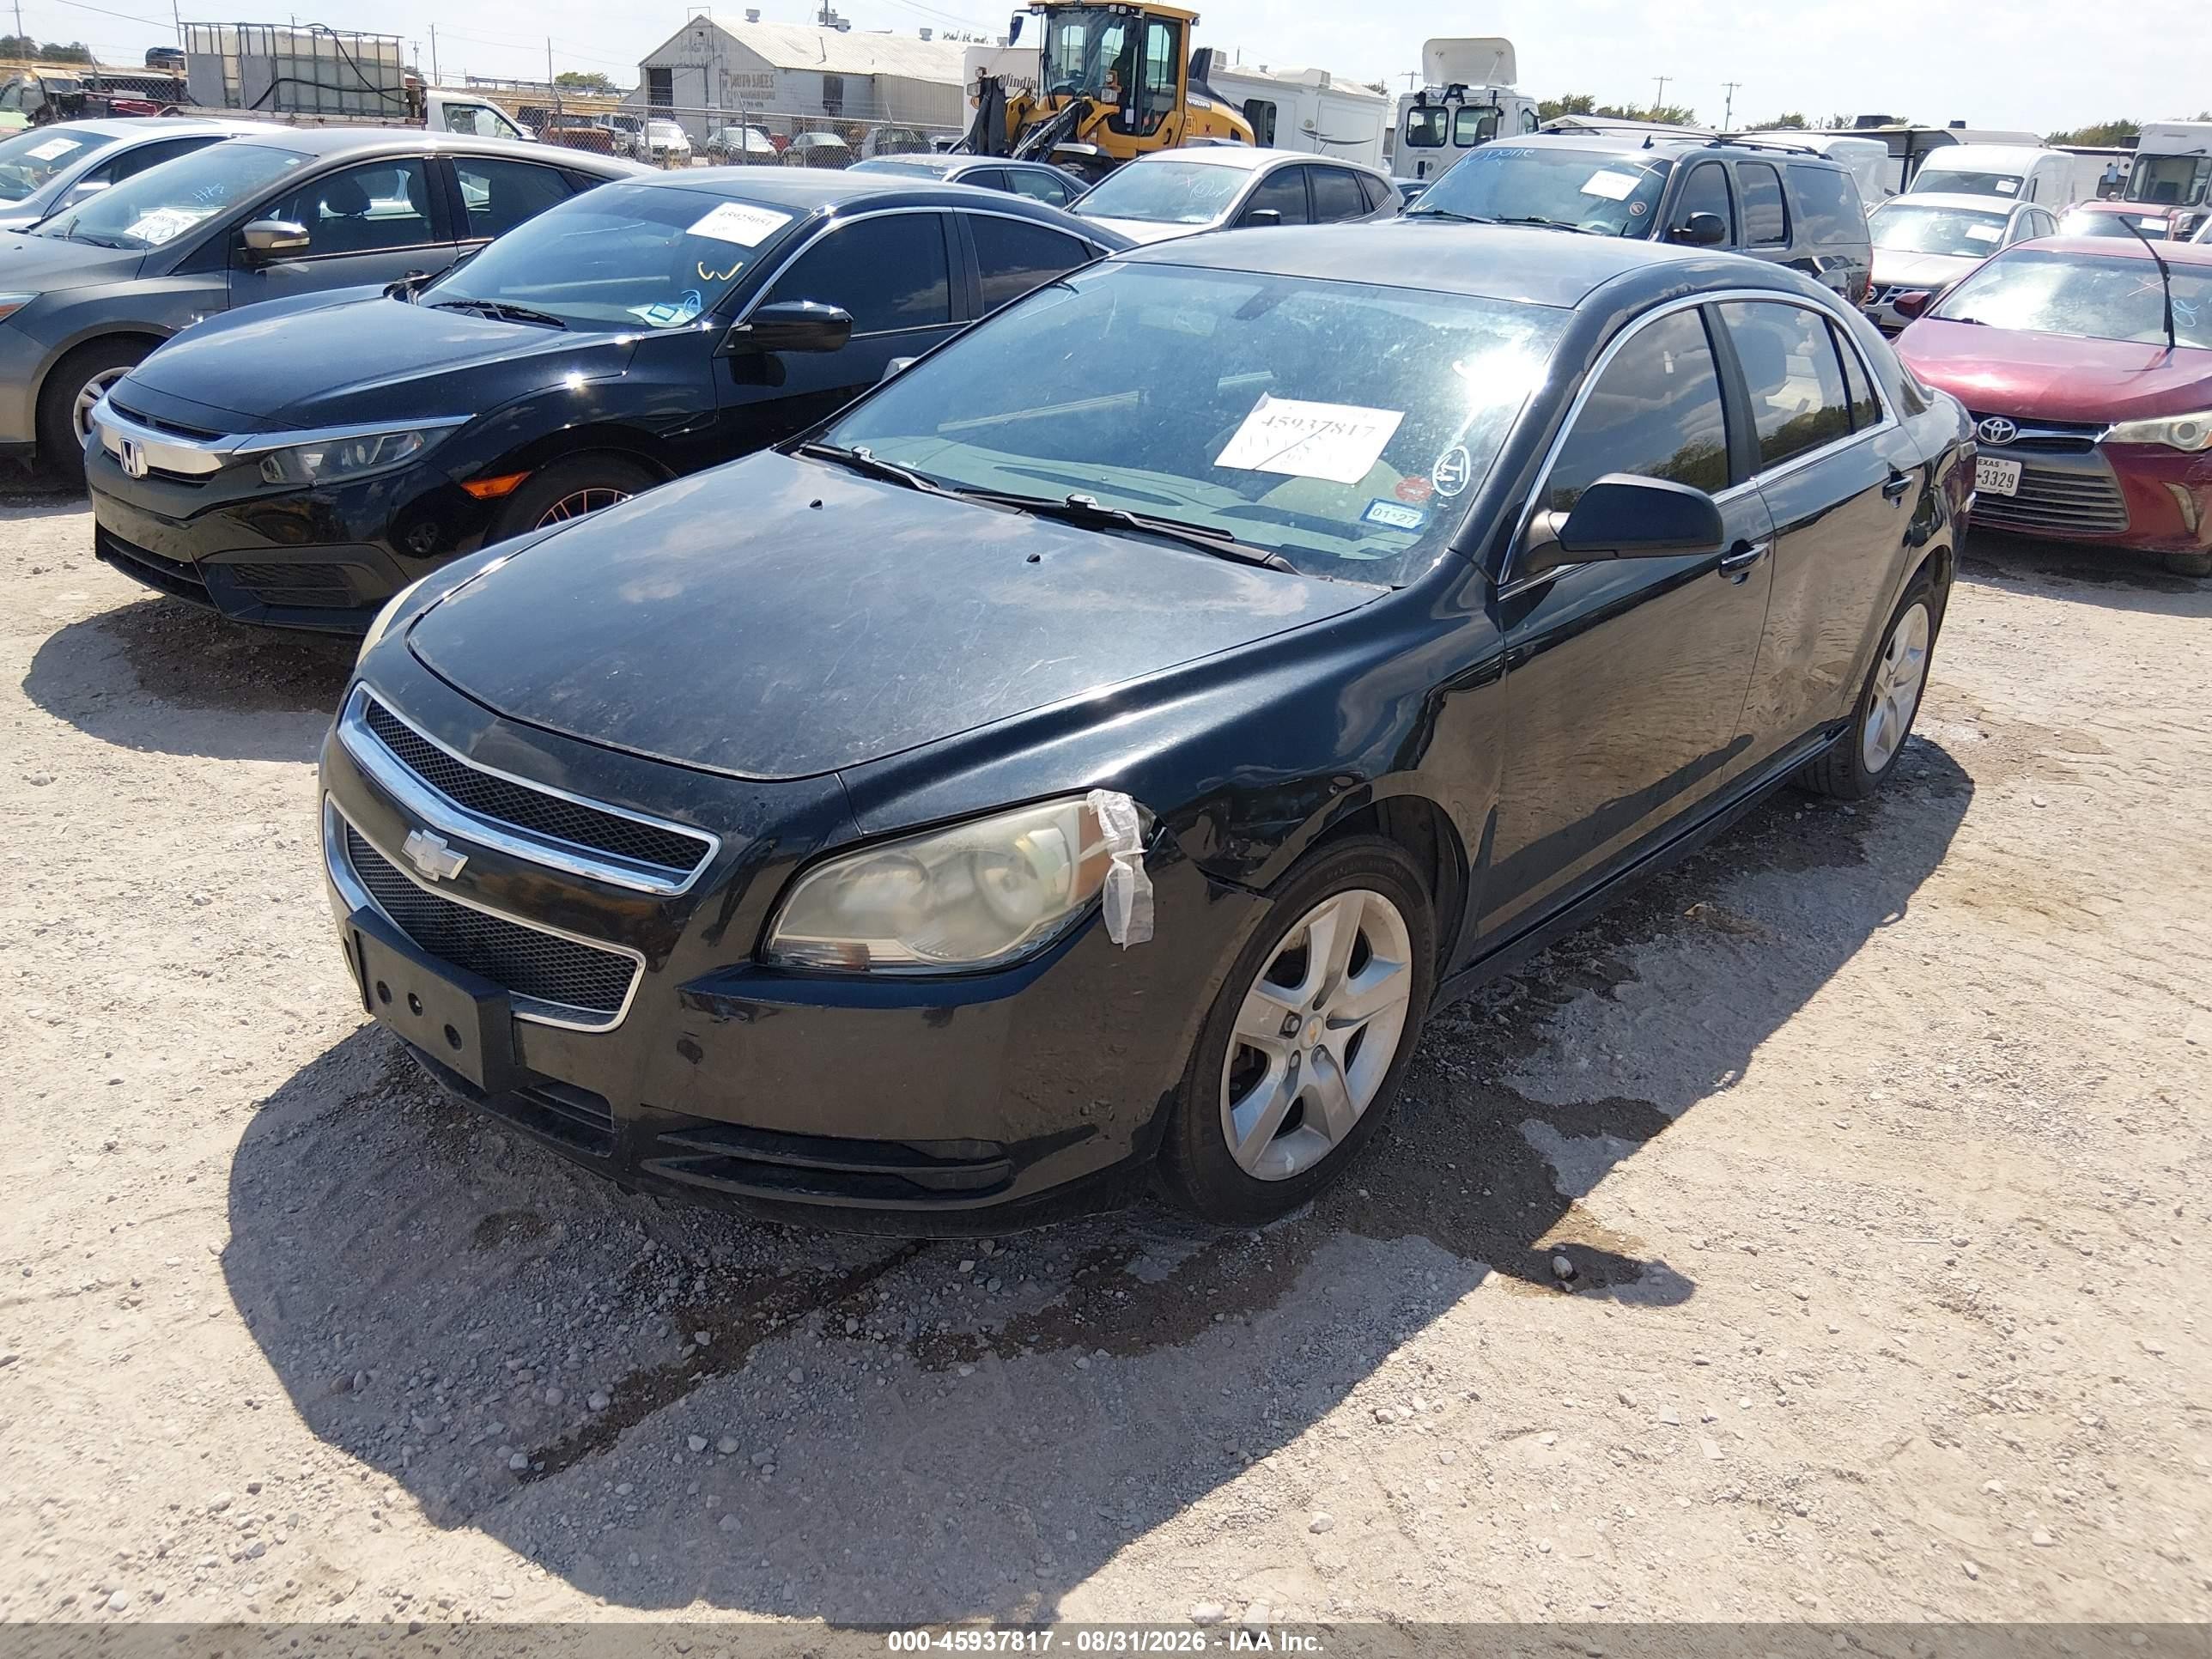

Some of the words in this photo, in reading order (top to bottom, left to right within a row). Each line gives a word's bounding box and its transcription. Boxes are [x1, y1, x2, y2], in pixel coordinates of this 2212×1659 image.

[1187, 97, 1210, 108] VOLVO
[1048, 122, 1060, 134] NOT
[1059, 112, 1073, 125] WALK
[1261, 415, 1376, 434] 45937817
[1978, 459, 2000, 468] EXAS
